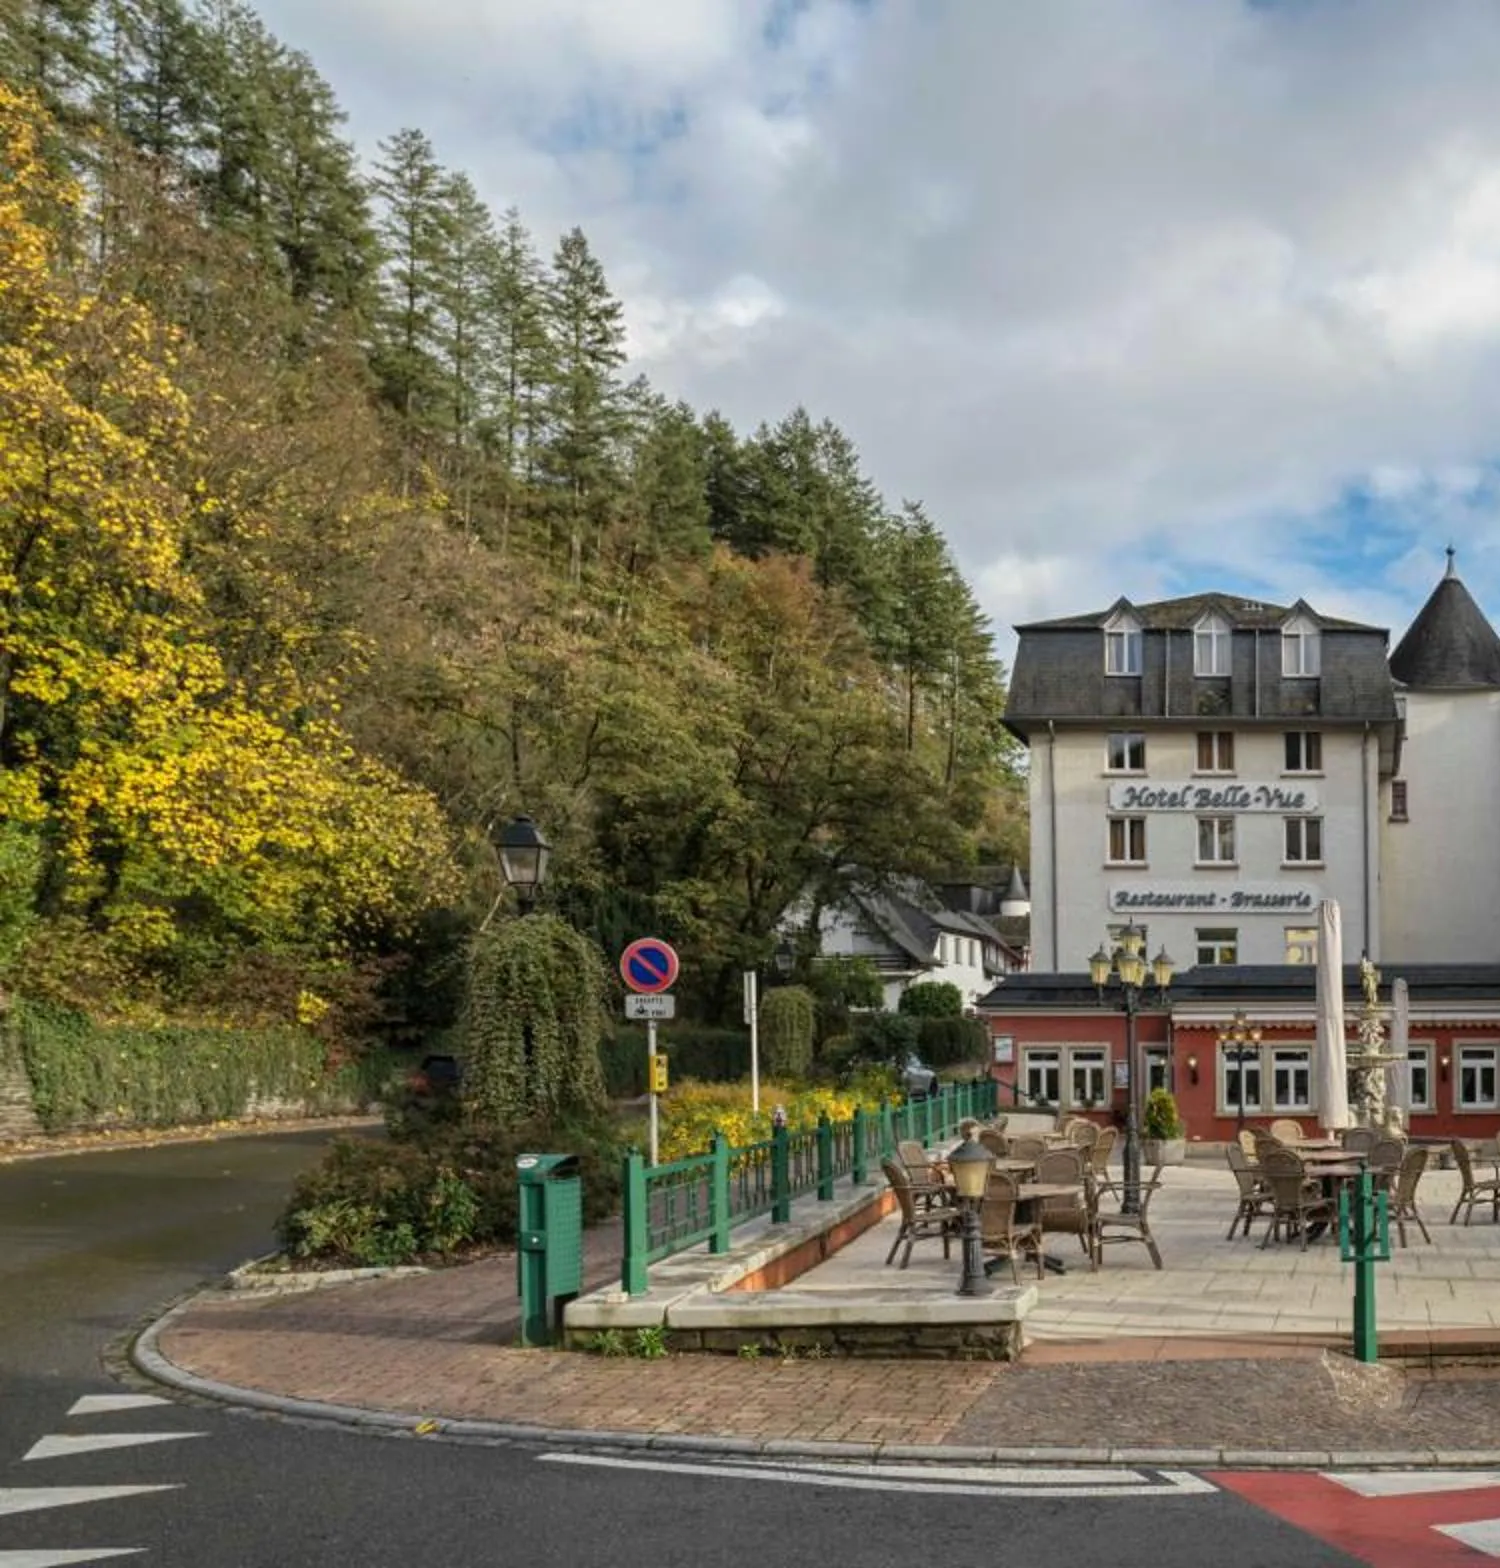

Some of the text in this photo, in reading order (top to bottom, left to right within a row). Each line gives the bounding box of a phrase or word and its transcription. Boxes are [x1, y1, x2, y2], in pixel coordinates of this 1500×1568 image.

[1123, 785, 1193, 809] Hotel
[1115, 890, 1216, 907] Restaurant
[1230, 890, 1312, 907] Brasserie
